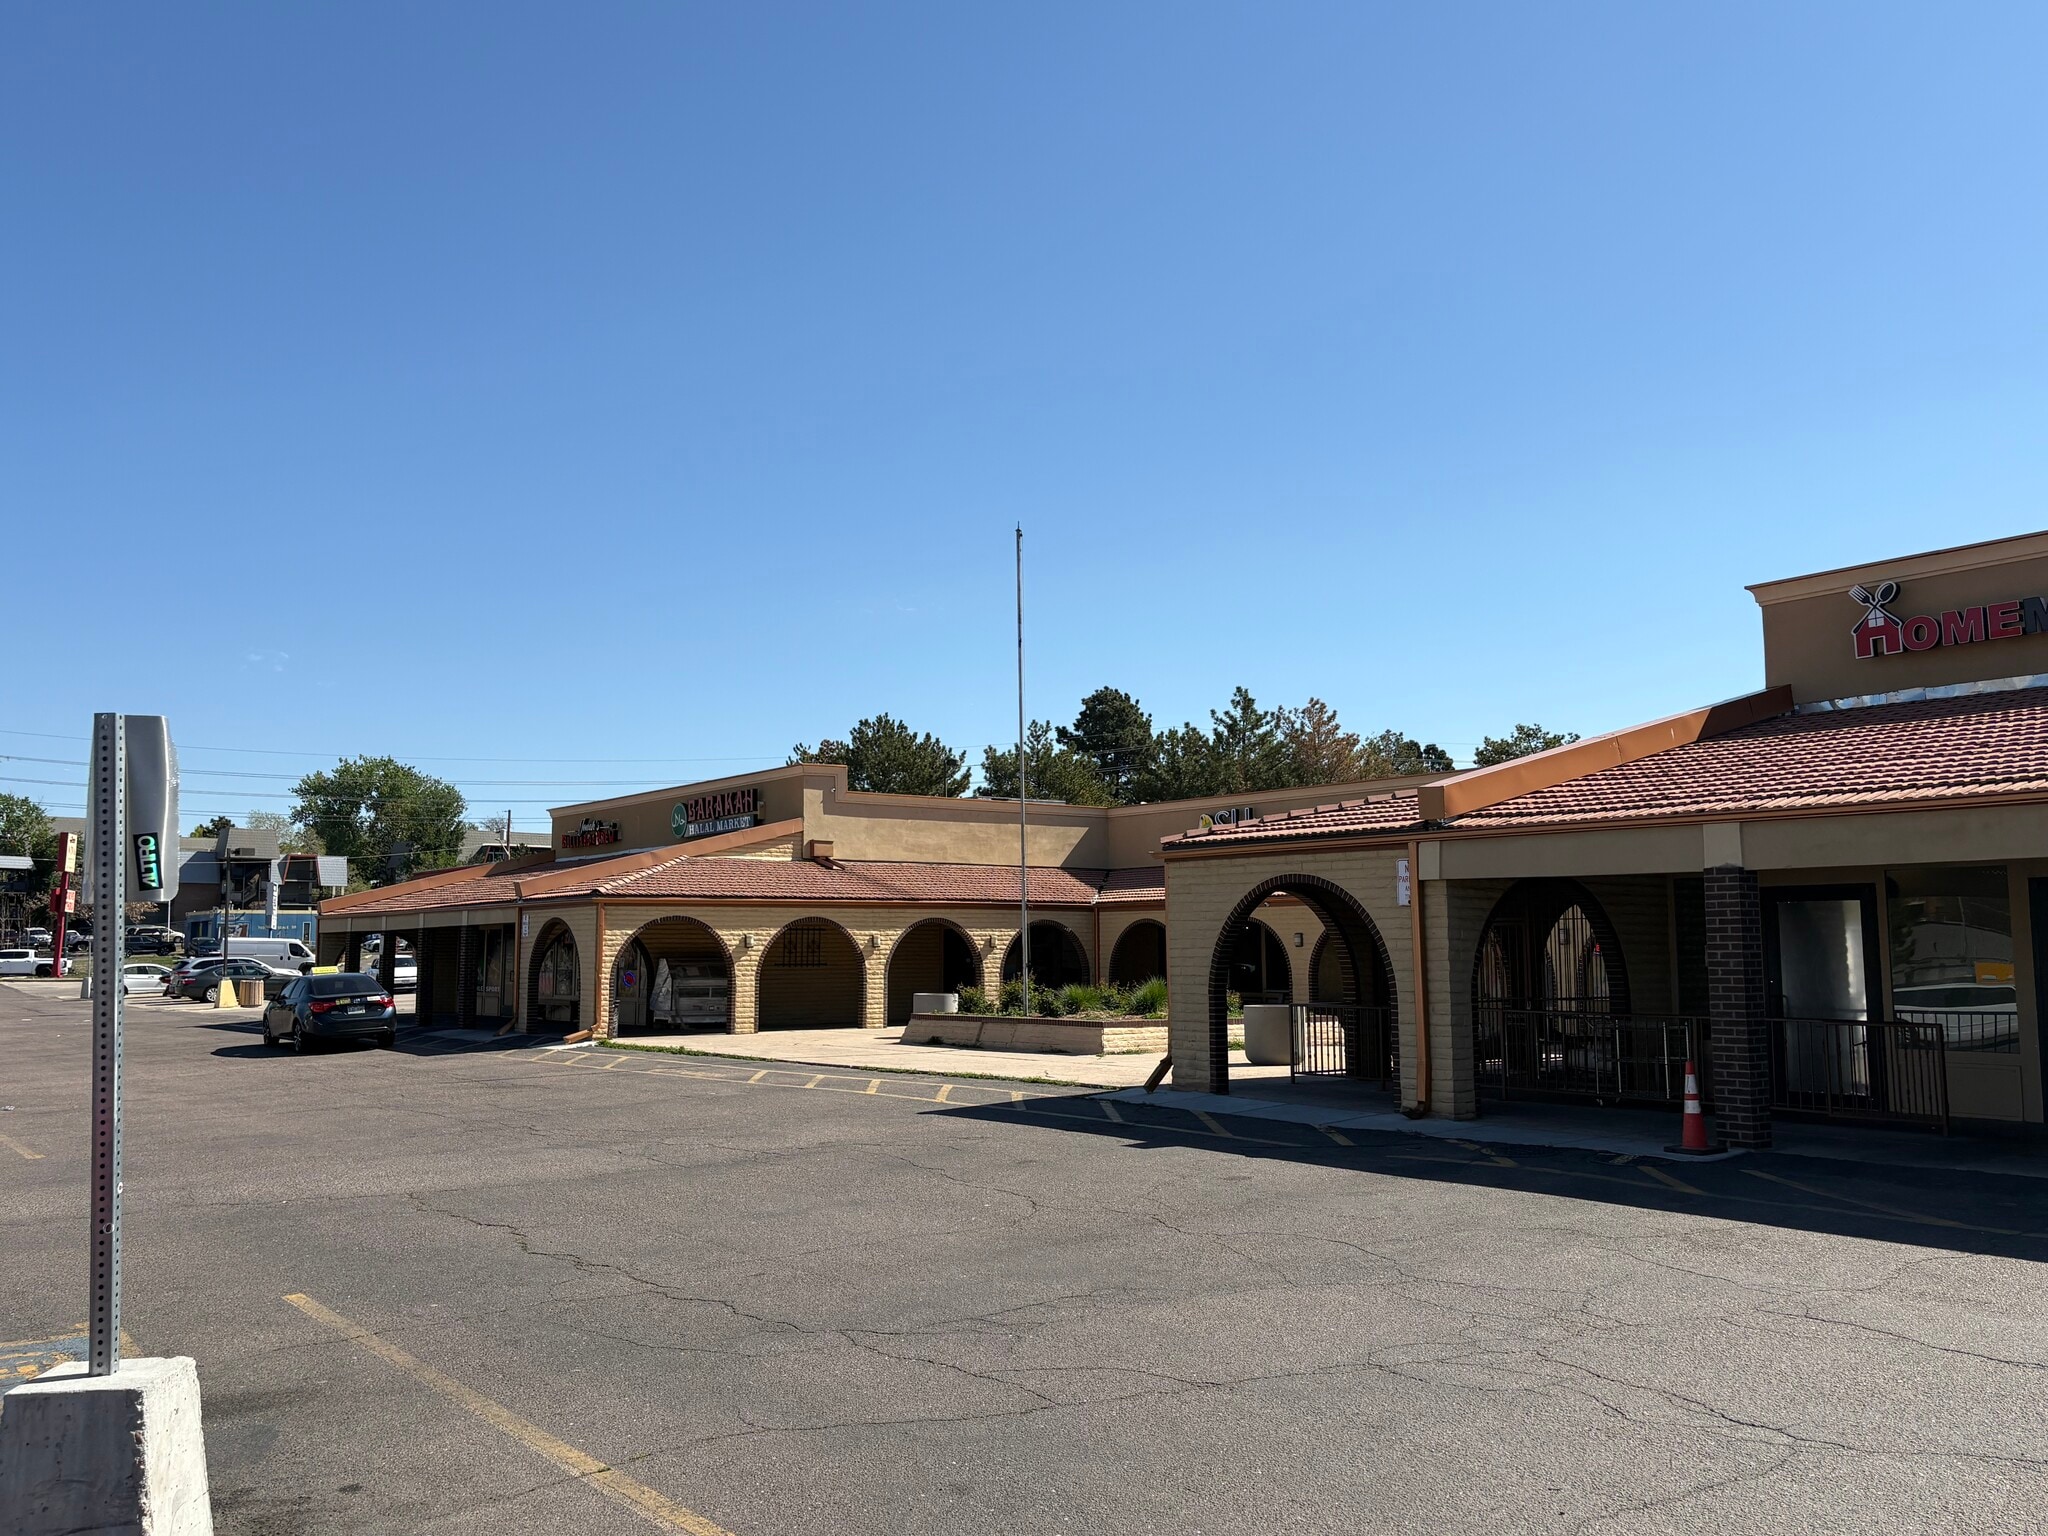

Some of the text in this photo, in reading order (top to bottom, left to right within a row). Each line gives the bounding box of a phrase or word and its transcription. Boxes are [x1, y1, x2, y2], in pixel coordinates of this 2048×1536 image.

[688, 789, 754, 821] BARAKAH
[688, 816, 751, 835] HALAL MARKET
[137, 835, 160, 888] ALTRO
